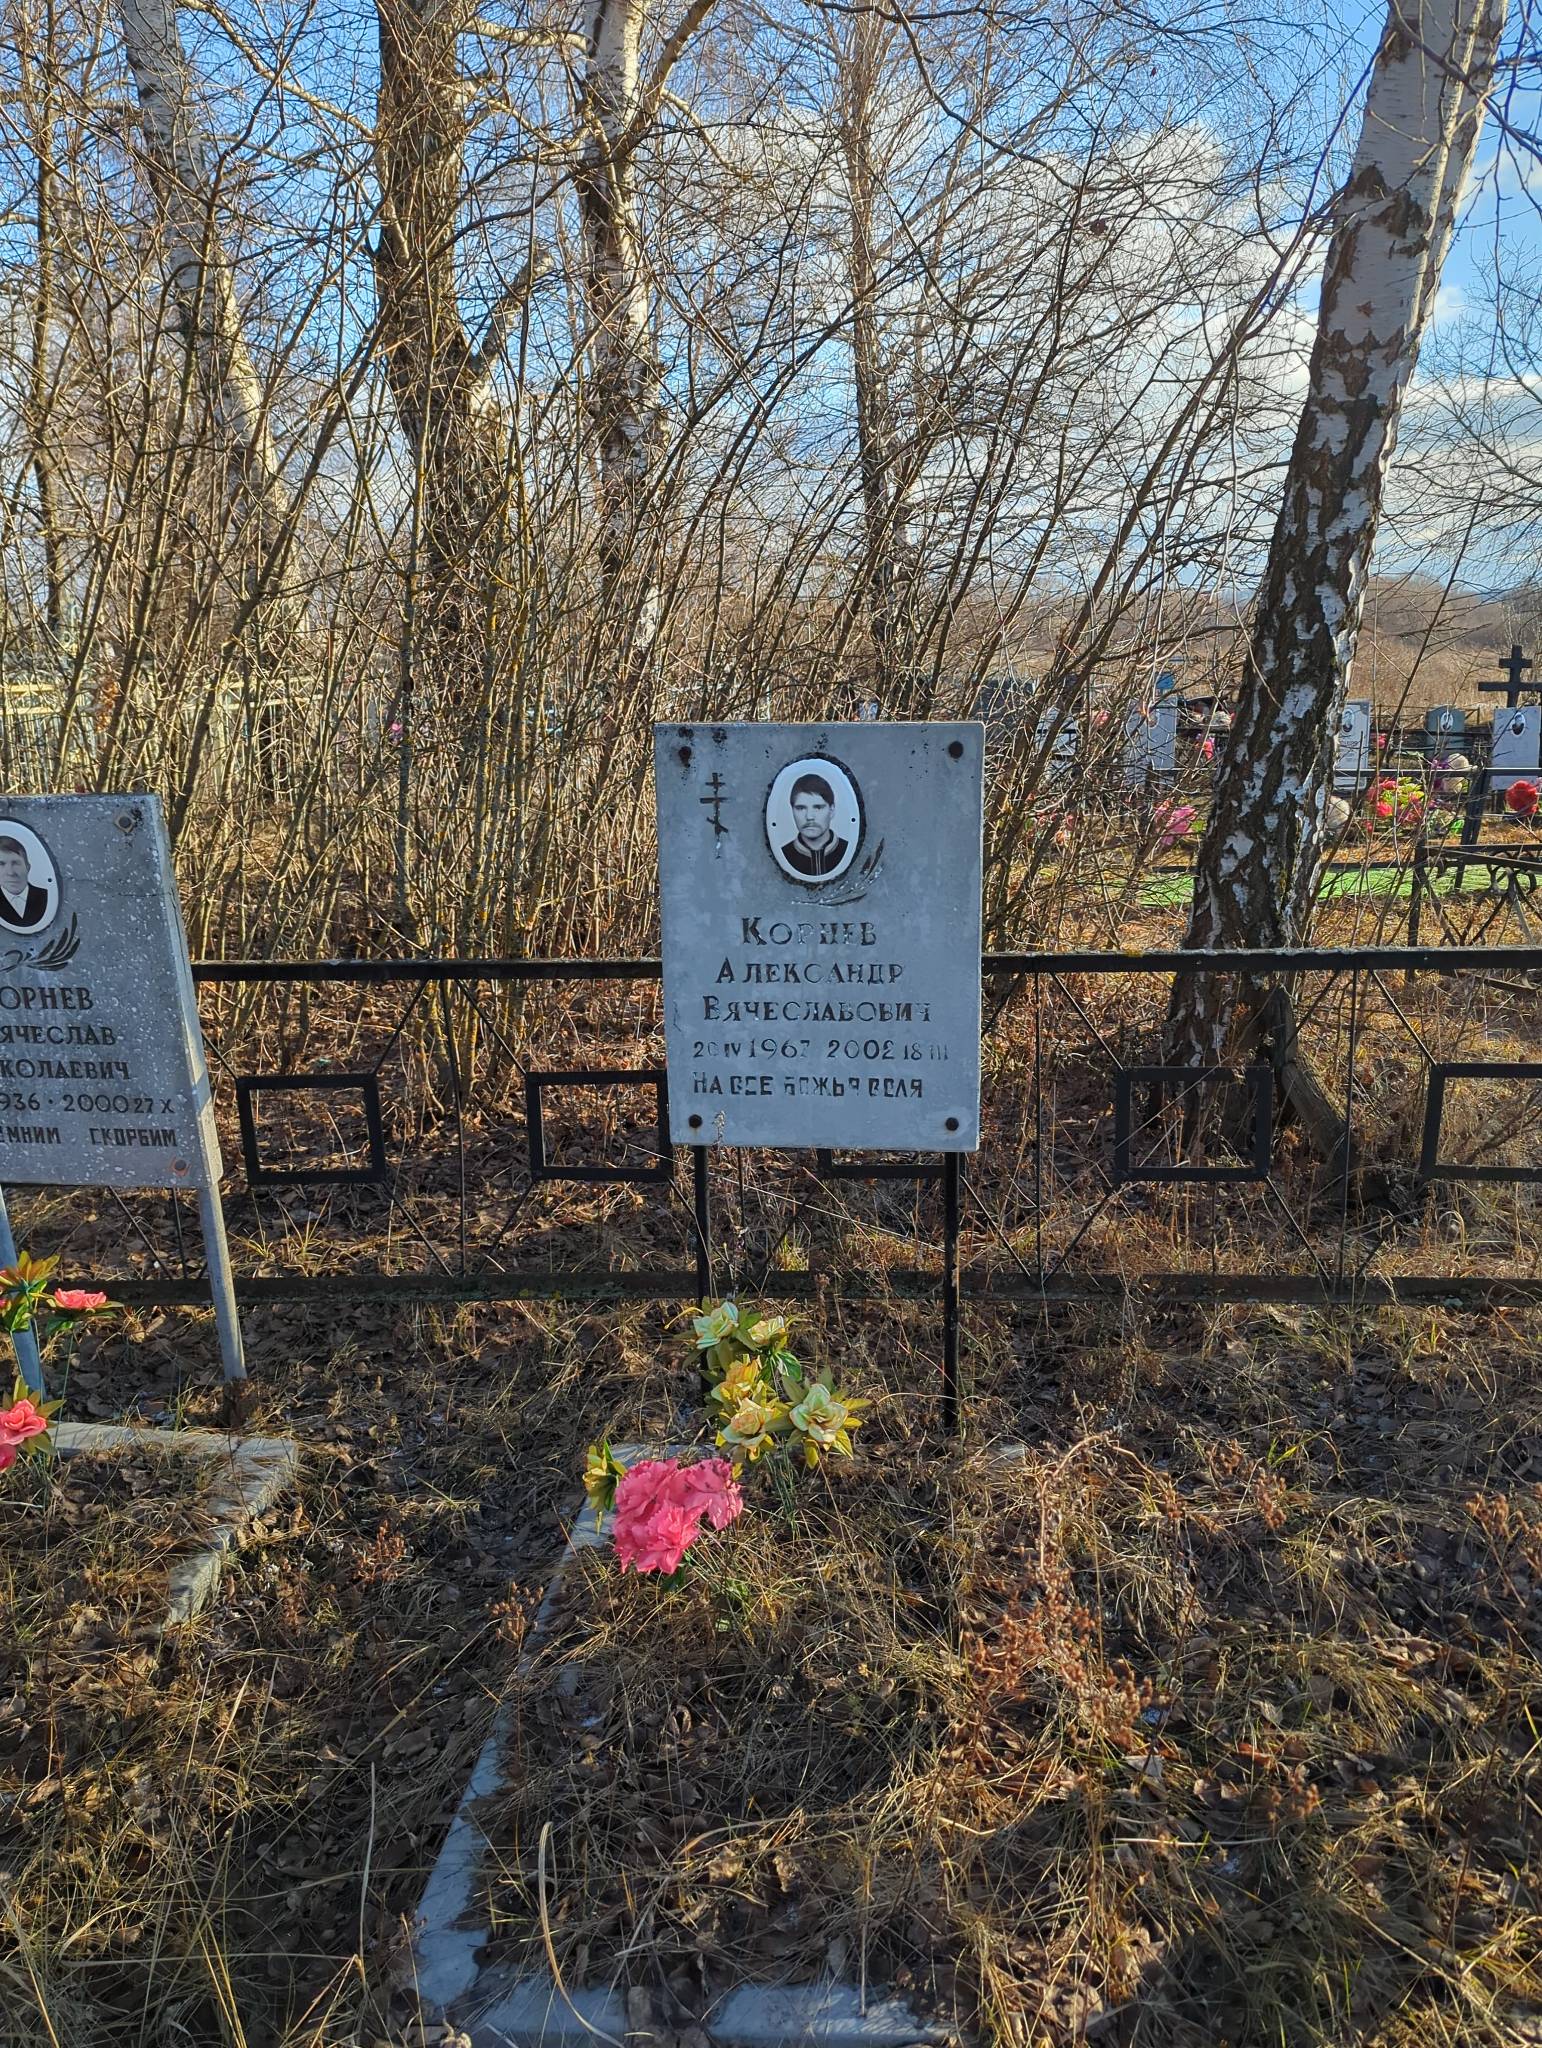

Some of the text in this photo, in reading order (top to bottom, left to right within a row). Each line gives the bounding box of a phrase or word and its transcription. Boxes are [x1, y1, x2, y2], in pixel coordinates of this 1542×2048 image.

[742, 916, 878, 946] КОРНЕВ
[715, 956, 904, 985] АЛЕКСАНДР
[702, 995, 932, 1022] ВЯЧЕСЛАВОВИЧ
[749, 1038, 810, 1060] 1967
[693, 1071, 723, 1096] НА
[730, 1075, 774, 1097] ВСЕ
[62, 1094, 129, 1114] 2000
[134, 1097, 153, 1114] 27
[0, 1126, 178, 1148] МНИМ СКОРБИМ
